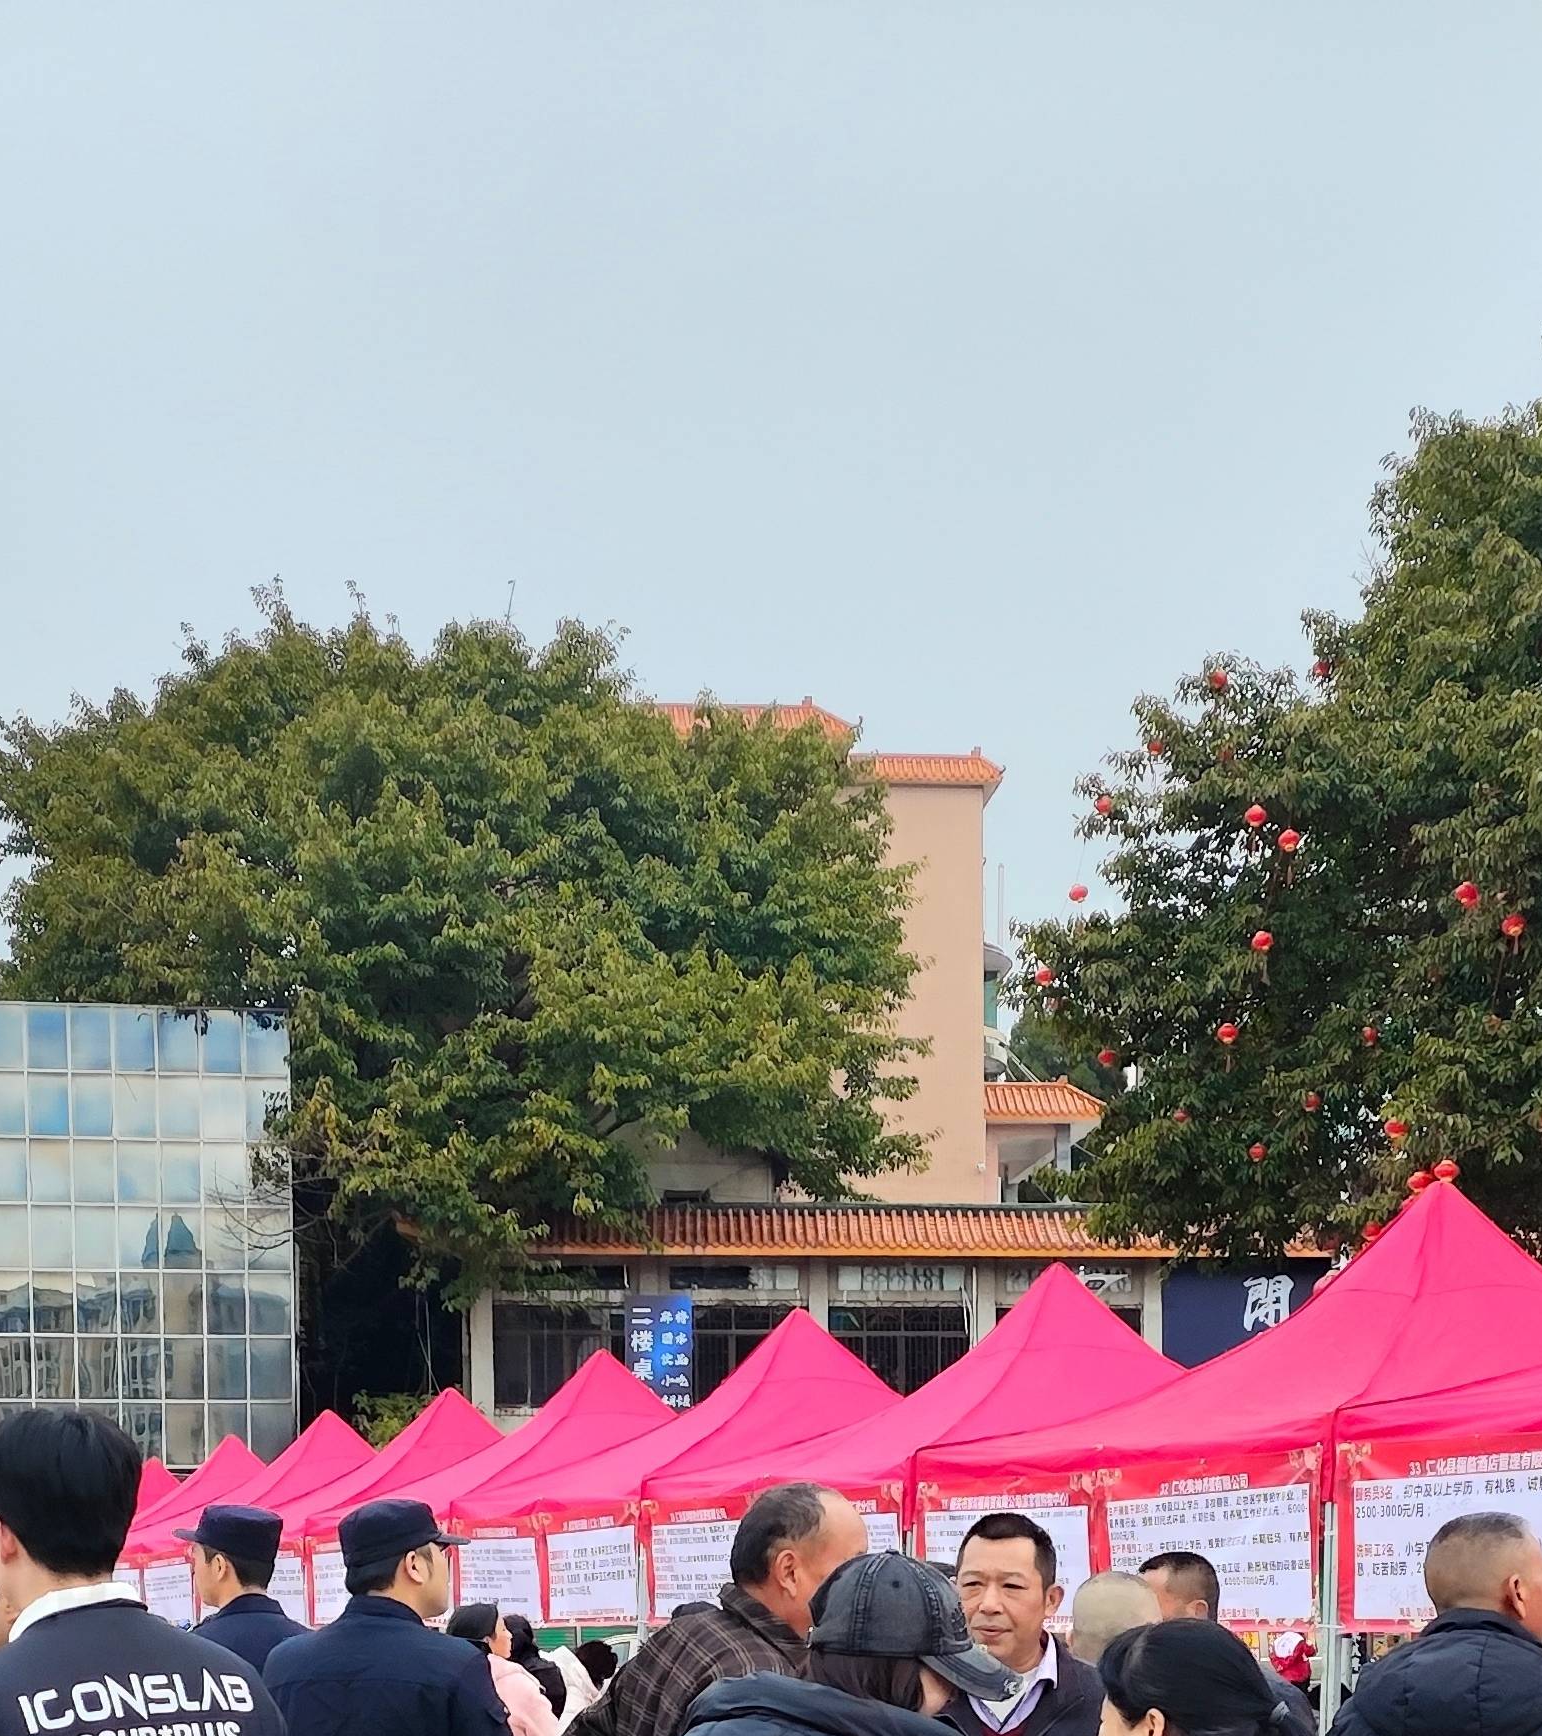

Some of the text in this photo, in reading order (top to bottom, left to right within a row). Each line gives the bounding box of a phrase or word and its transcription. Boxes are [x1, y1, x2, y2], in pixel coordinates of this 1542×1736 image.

[1409, 1461, 1422, 1476] 33
[1357, 1561, 1426, 1577] 恳，吃苦耐劳，2
[17, 1667, 255, 1735] ICONSLAB
